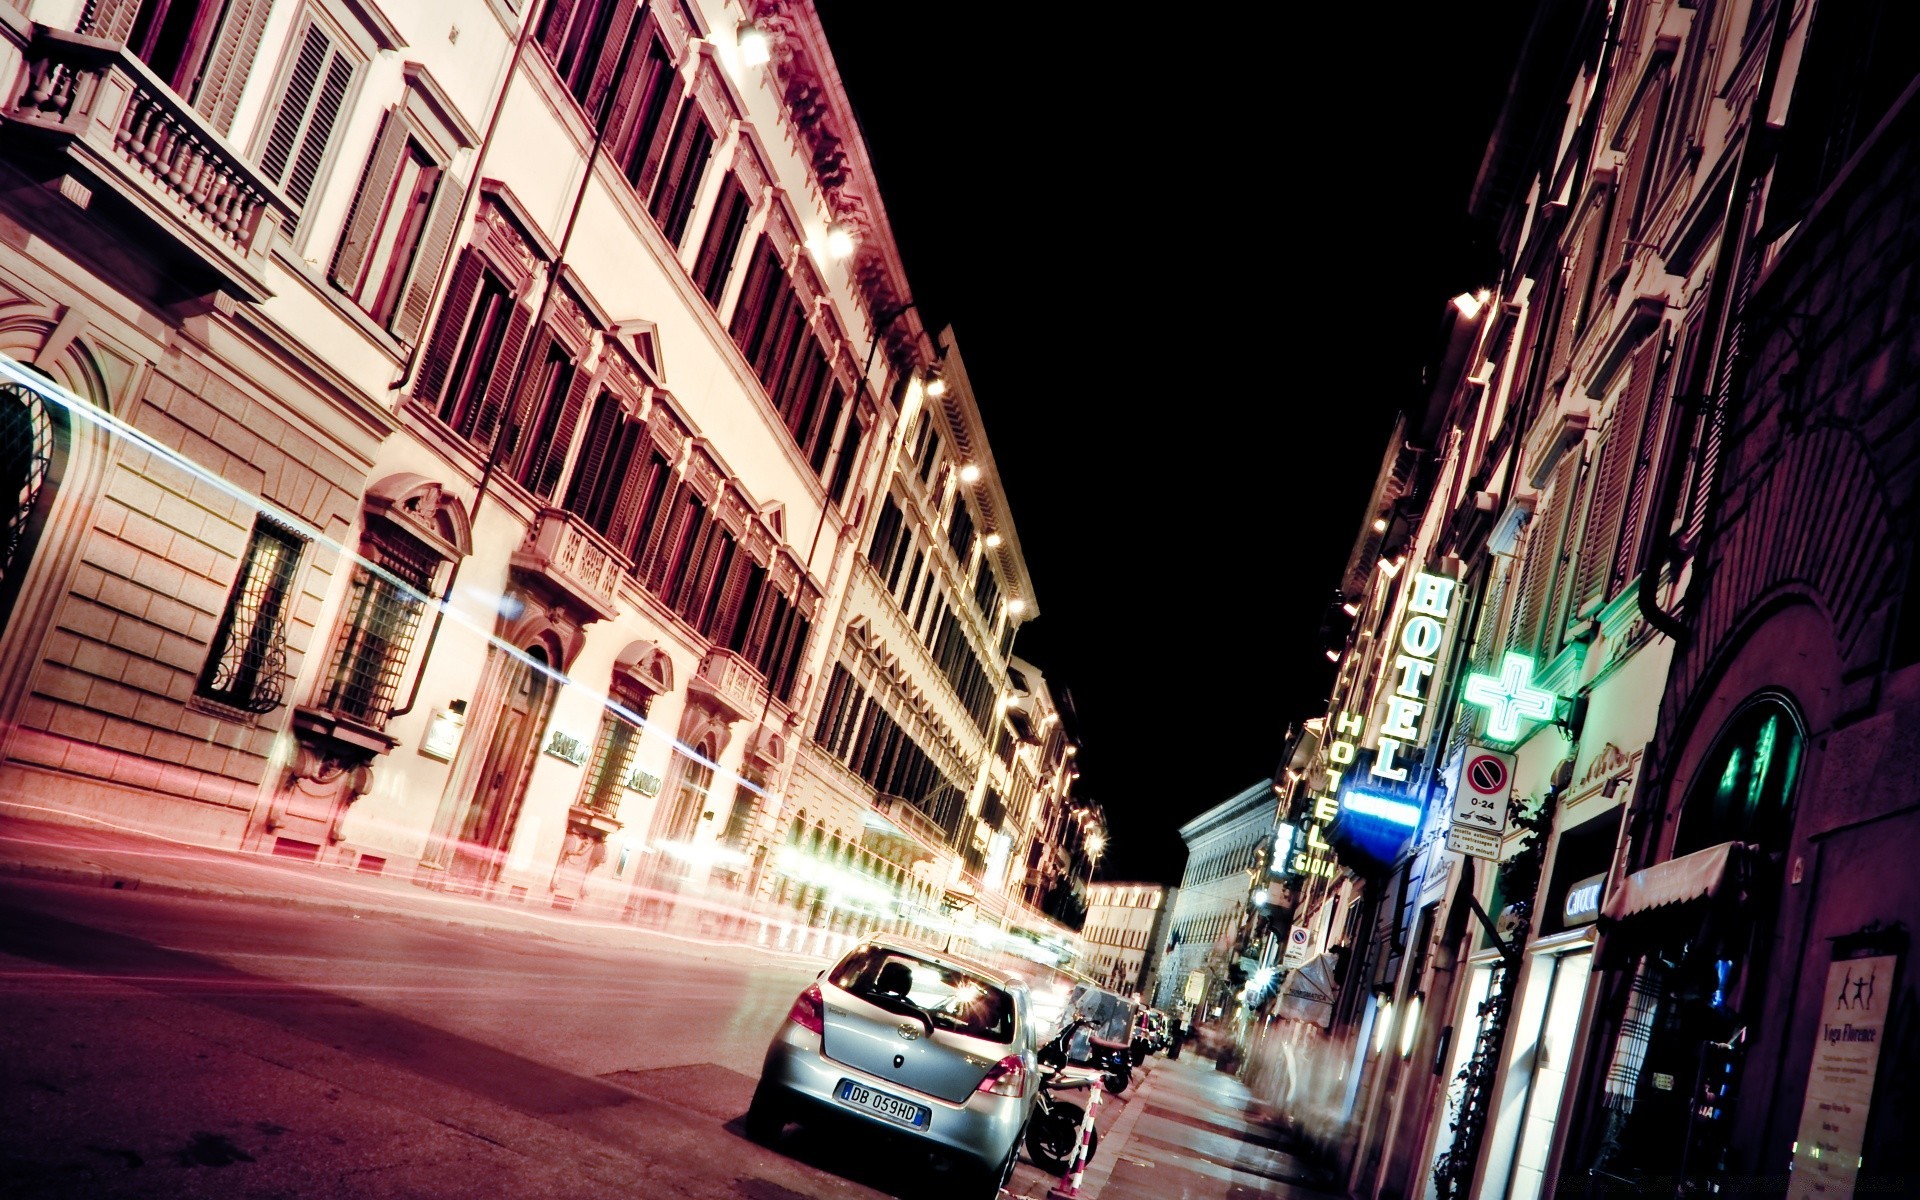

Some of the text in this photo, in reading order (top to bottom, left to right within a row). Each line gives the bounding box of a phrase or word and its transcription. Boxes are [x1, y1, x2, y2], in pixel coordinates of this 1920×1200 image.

[1371, 572, 1455, 782] HOTEL
[1307, 711, 1363, 850] HOTEL
[1471, 797, 1494, 809] 0-24
[1476, 847, 1494, 856] minuti
[1295, 853, 1335, 879] GIOIA
[1824, 1023, 1876, 1046] Yoga Florence
[851, 1087, 869, 1104] DB
[872, 1095, 915, 1120] 059HD
